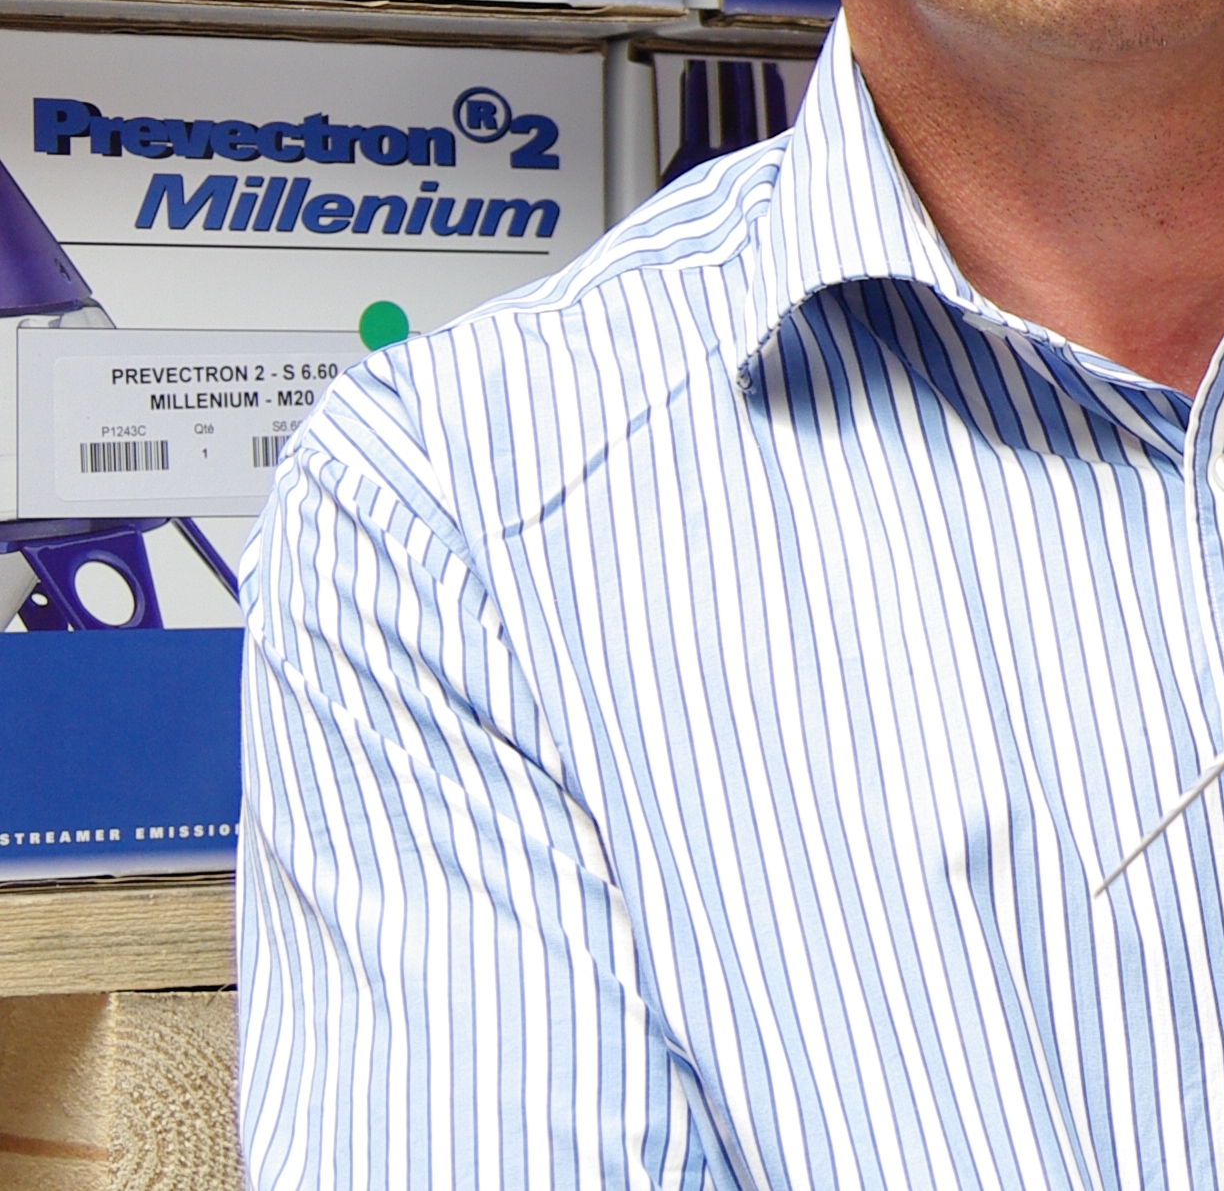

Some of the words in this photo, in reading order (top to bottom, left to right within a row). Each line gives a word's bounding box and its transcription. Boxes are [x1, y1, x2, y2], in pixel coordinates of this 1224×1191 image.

[135, 173, 560, 237] Millenium
[112, 366, 248, 385] PREVECTRON
[254, 365, 265, 381] 2
[283, 364, 295, 380] S
[301, 363, 338, 380] 6.60
[150, 392, 259, 411] MILLENIUM
[277, 390, 315, 407] M20
[101, 425, 146, 437] P1243C
[194, 423, 214, 434] Qté
[202, 448, 208, 459] 1
[0, 828, 120, 847] STREAMER
